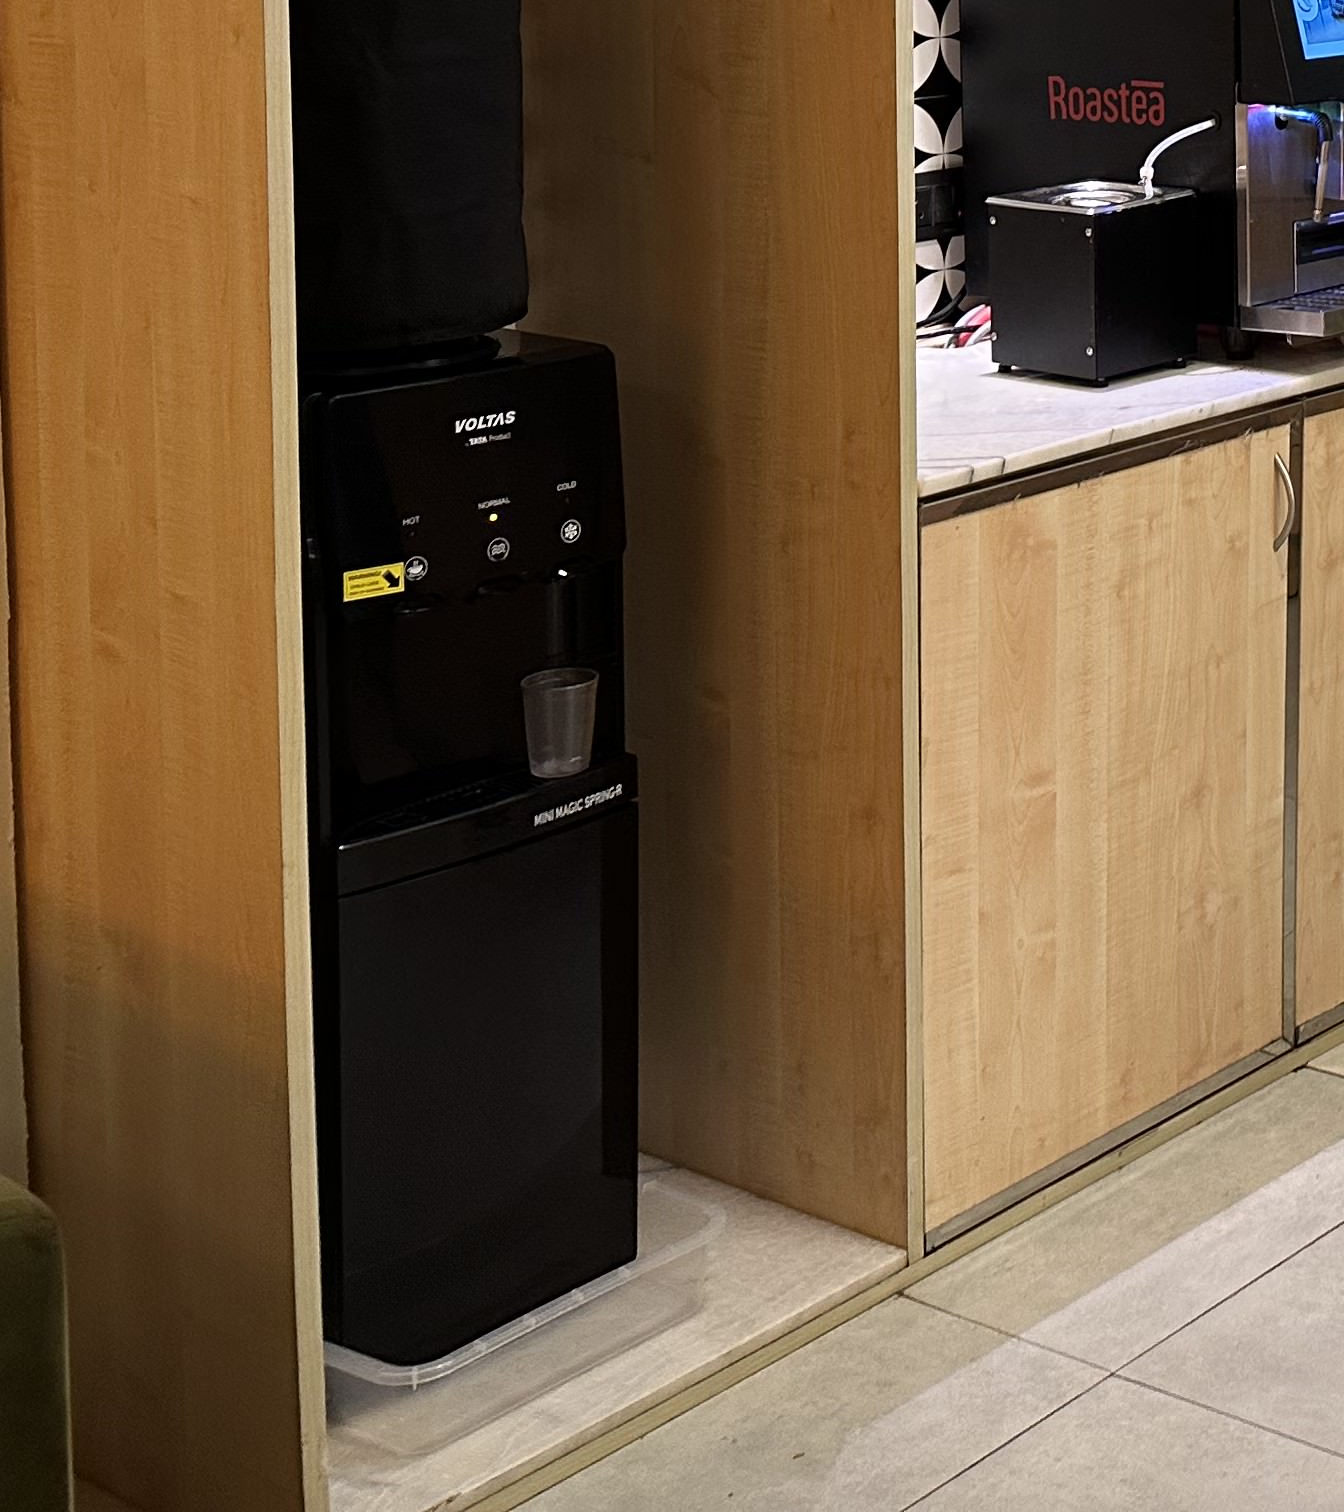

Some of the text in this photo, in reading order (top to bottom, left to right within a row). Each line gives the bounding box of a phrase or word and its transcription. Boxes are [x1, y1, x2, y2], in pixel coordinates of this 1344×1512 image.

[454, 410, 516, 434] VOLTAS
[402, 515, 421, 527] HOT
[555, 797, 584, 819] MAGIC
